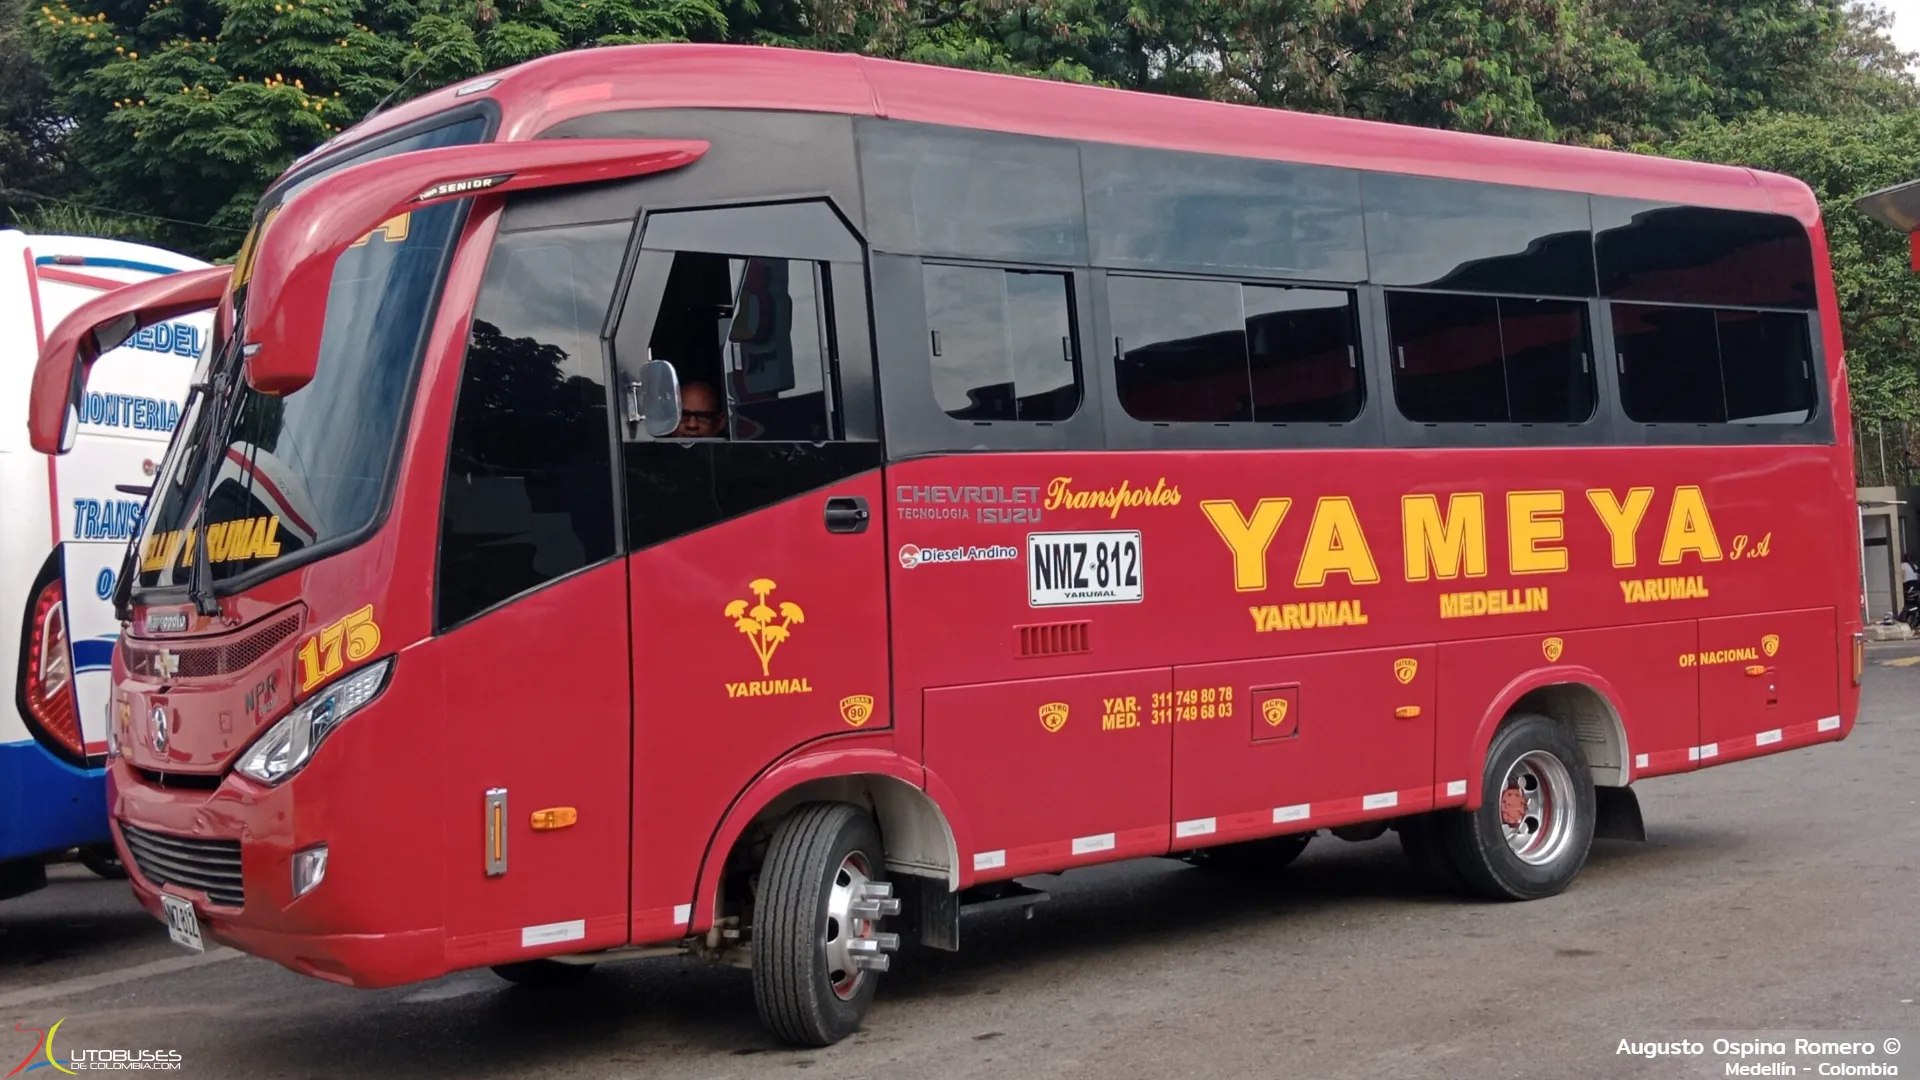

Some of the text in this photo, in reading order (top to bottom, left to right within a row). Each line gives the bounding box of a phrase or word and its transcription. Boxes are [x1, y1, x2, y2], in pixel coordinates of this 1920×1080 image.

[438, 178, 492, 194] SENIOR
[896, 485, 1040, 504] CHEVROLET
[1044, 476, 1181, 519] Transportes
[897, 508, 1042, 524] TECNOLOGIA ISUZU
[182, 516, 281, 568] YRUMAL
[920, 544, 1018, 563] Diesel Andino
[1034, 540, 1138, 590] NMZ 812
[1063, 590, 1117, 599] YARUMAL
[1440, 587, 1549, 619] MEDELLIN
[1620, 576, 1709, 603] YARUMAL
[1250, 599, 1368, 633] YARUMAL
[298, 603, 382, 692] 175
[1679, 647, 1759, 667] OP. NACIONAL
[724, 678, 813, 699] YARUMAL
[1103, 686, 1233, 714] YAR. 311 749 80 78
[849, 707, 864, 719] 90
[1102, 702, 1233, 731] MED. 311 749 68 03
